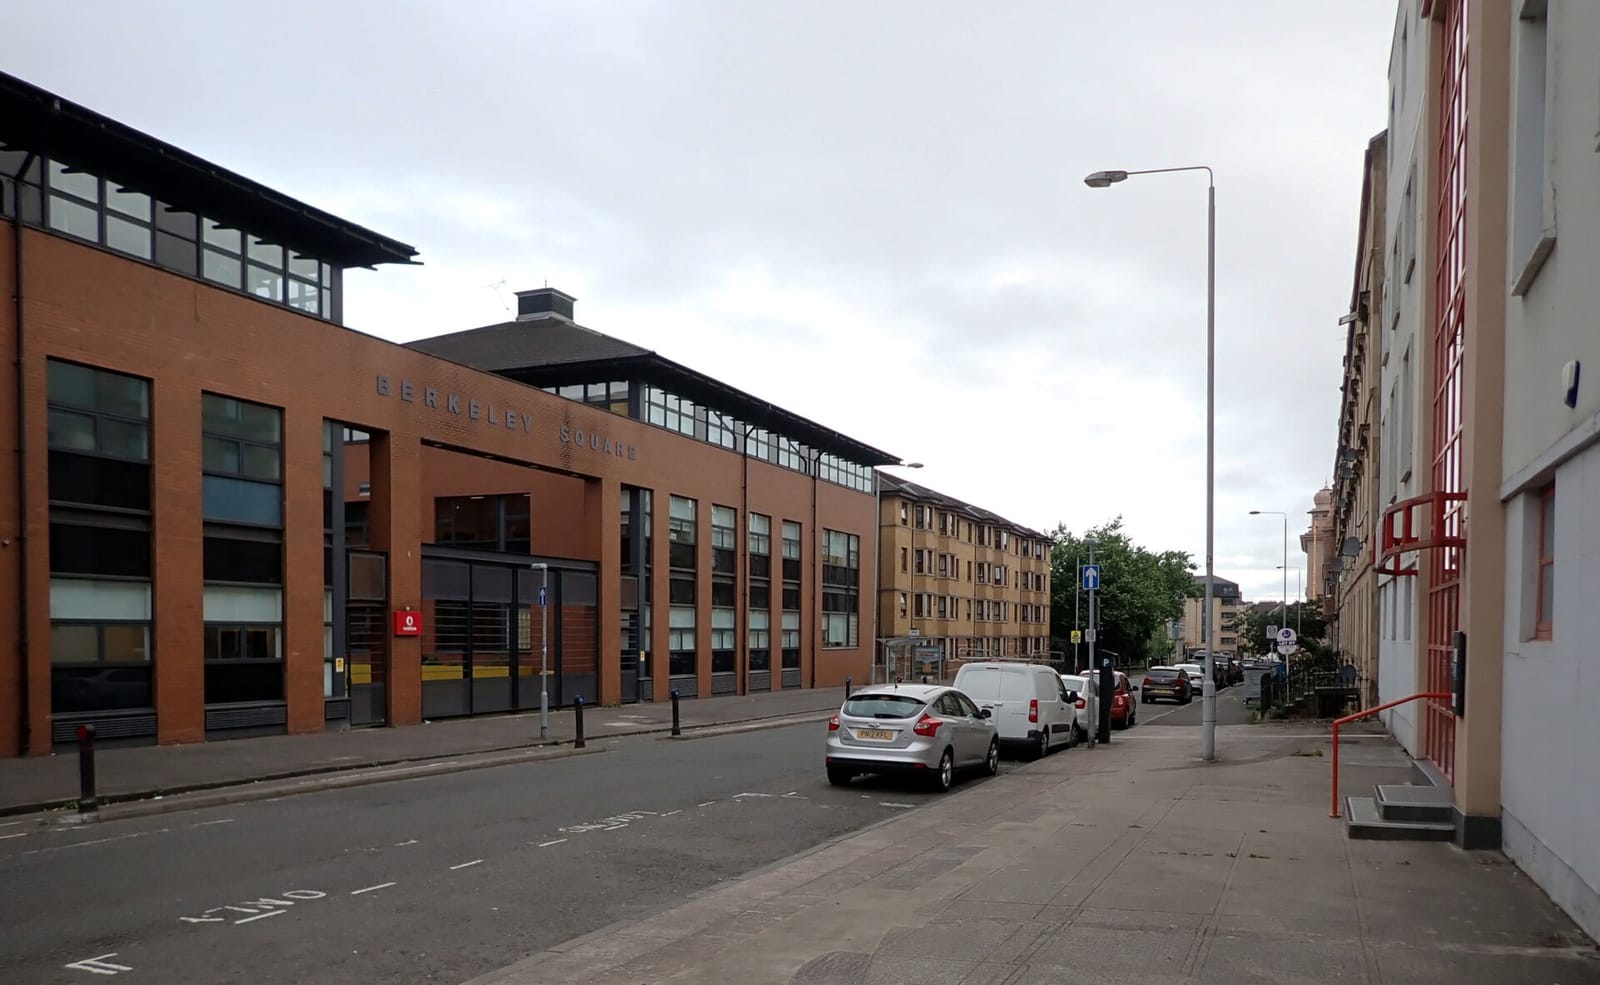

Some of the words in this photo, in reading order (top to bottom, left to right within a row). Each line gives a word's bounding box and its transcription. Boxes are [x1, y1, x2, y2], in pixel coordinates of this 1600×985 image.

[376, 374, 533, 432] BERKELEY
[559, 424, 637, 460] SQUARE
[1103, 658, 1110, 667] P
